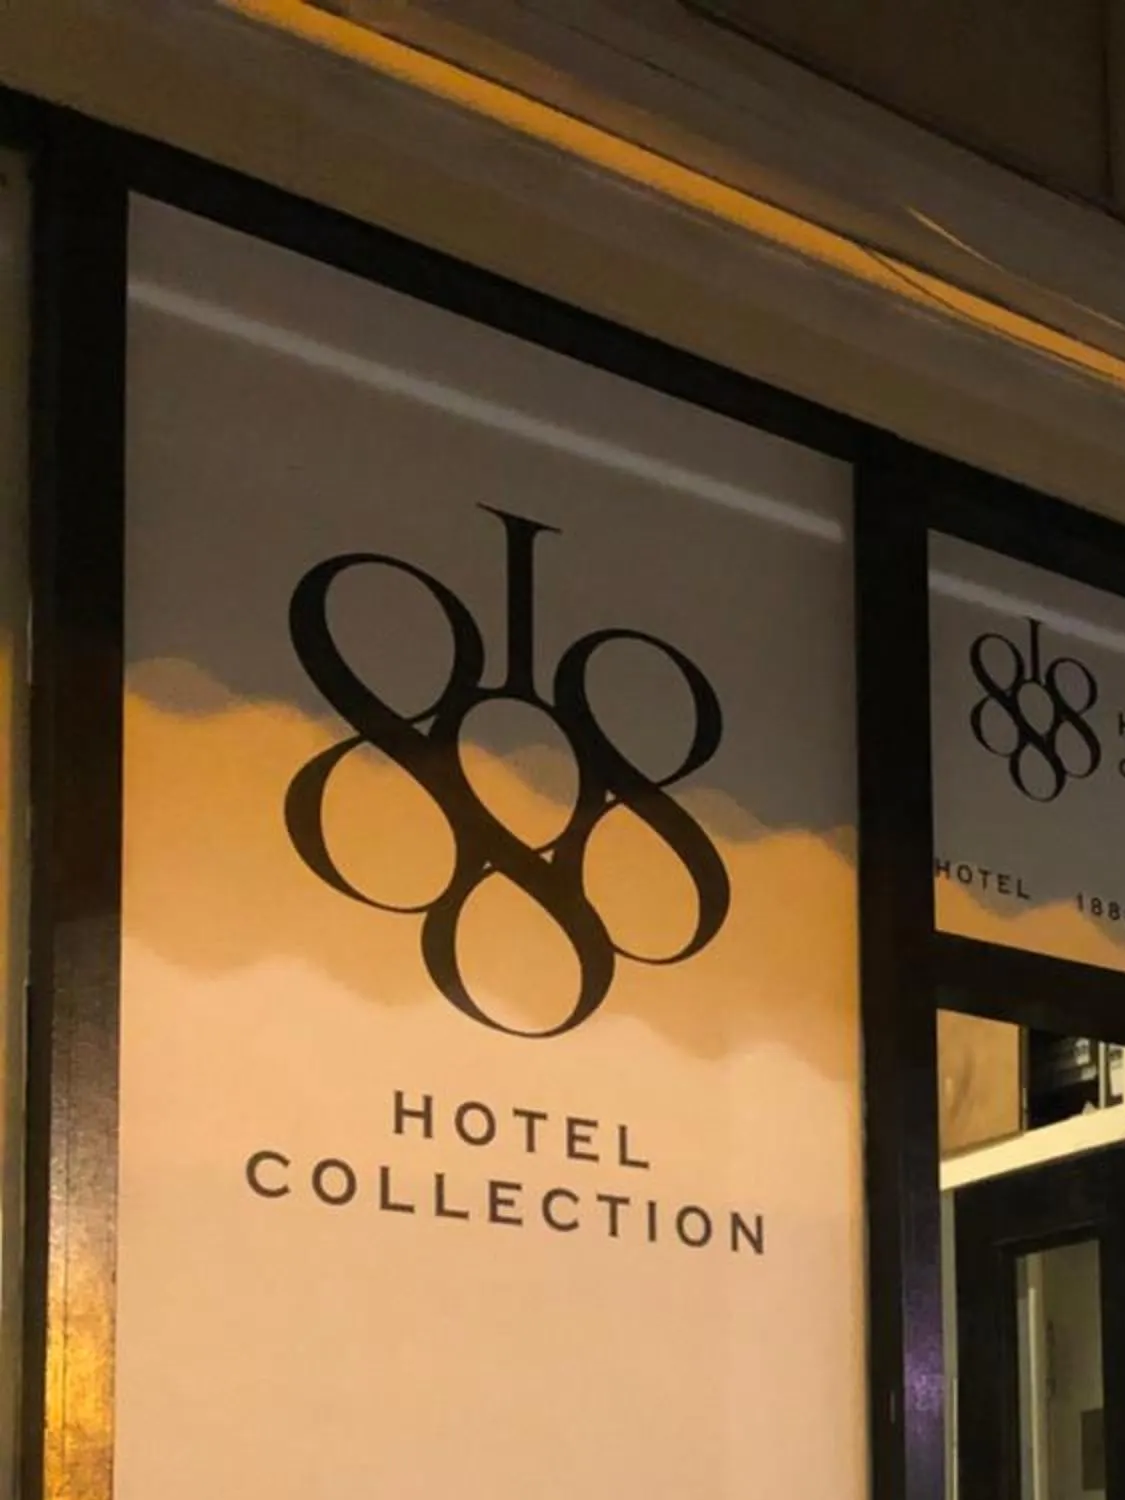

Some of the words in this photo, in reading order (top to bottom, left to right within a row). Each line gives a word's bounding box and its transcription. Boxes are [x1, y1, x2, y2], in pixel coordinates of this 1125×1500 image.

[935, 857, 1031, 900] HOTEL
[392, 1089, 651, 1170] HOTEL
[245, 1149, 765, 1256] COLLECTION
